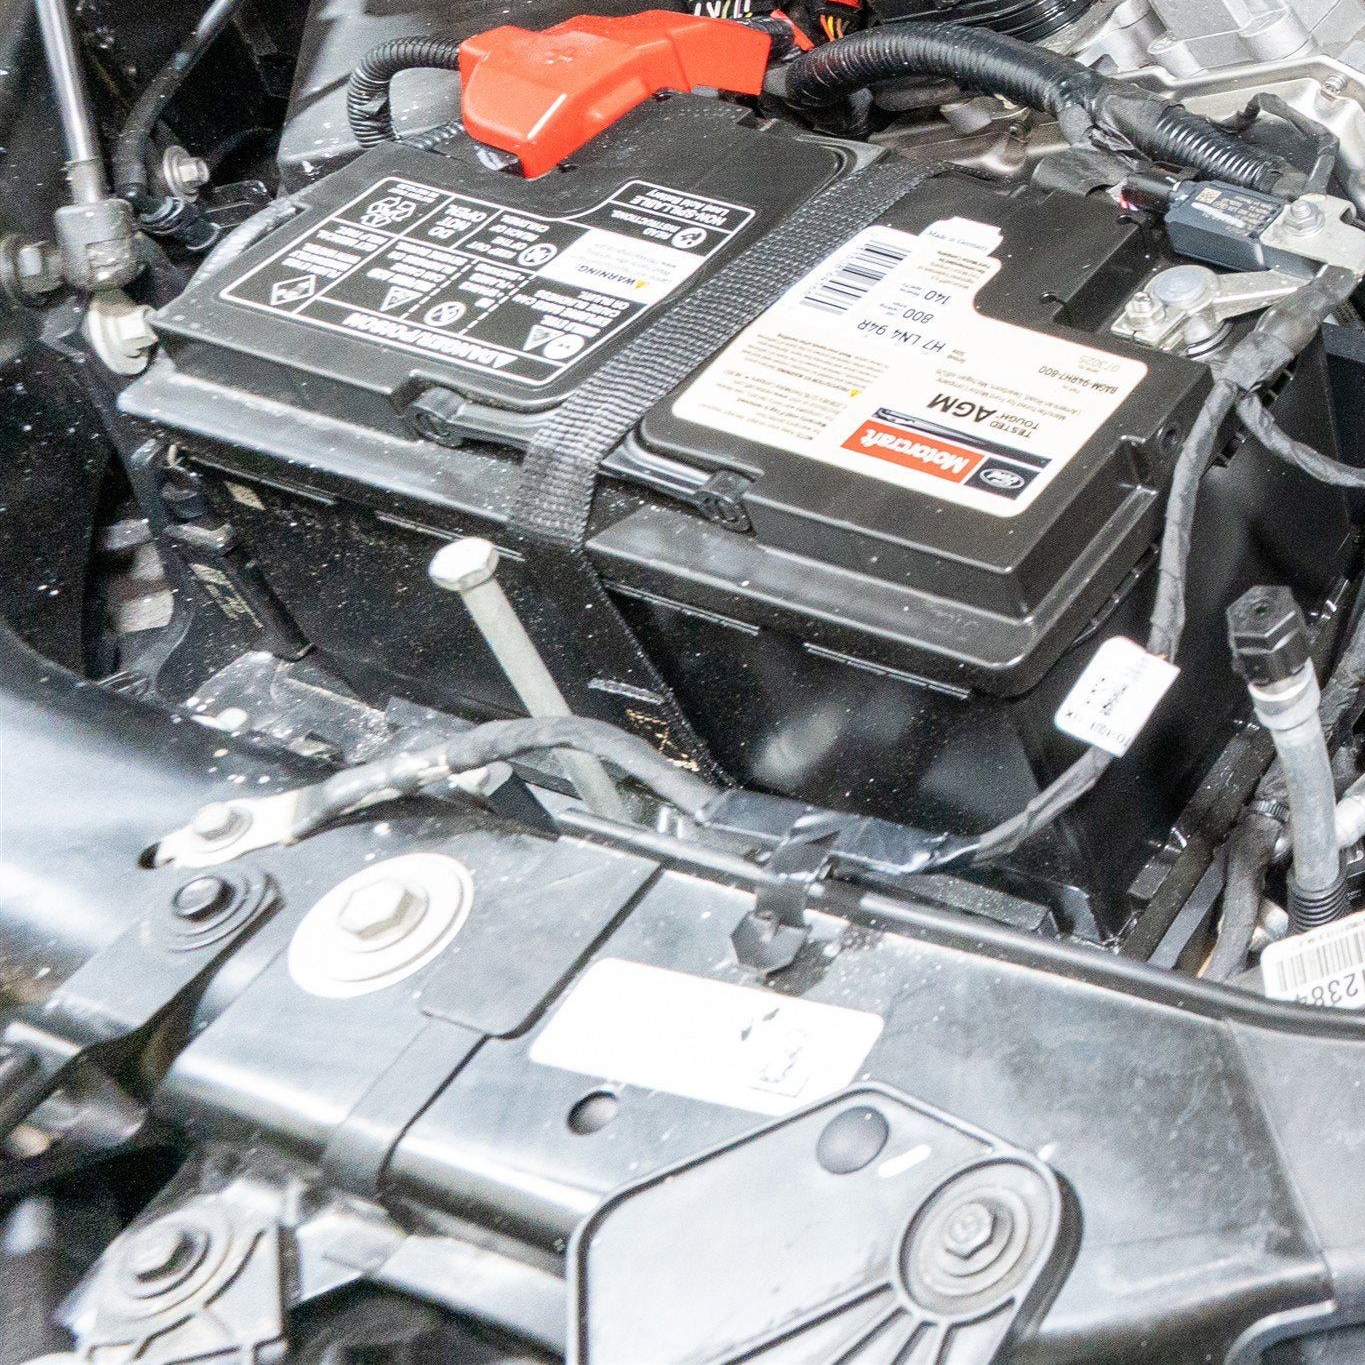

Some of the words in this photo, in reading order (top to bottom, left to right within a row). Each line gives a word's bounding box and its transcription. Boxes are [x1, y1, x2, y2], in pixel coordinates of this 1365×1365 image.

[643, 187, 685, 205] Battery
[677, 197, 706, 211] Acid
[439, 202, 490, 223] OPEN.
[628, 191, 728, 228] NON-SPILLABLE
[700, 202, 731, 217] Lead
[434, 214, 473, 231] NOT
[486, 223, 509, 233] OF
[496, 213, 551, 234] CHILDREN.
[607, 206, 682, 235] INSTRUCTIONS.
[424, 224, 457, 239] DO
[500, 226, 541, 242] REACH
[641, 226, 673, 240] READ
[463, 239, 494, 252] OUT
[488, 235, 515, 247] THE
[507, 240, 529, 251] OF
[384, 249, 409, 261] OR
[485, 245, 518, 259] KEEP
[387, 261, 428, 277] CAUSE
[418, 269, 449, 283] CAN
[508, 292, 539, 306] CAN
[608, 299, 632, 311] OR
[921, 289, 952, 305] 140
[583, 302, 623, 319] CAUSE
[900, 307, 935, 324] 800
[854, 318, 890, 335] 94R
[338, 311, 503, 364] DANGER/POISON
[888, 327, 923, 345] LN4
[919, 338, 947, 353] H7
[924, 392, 998, 424] AGM
[987, 419, 1034, 438] TESTED
[853, 427, 971, 474] Motorcraft
